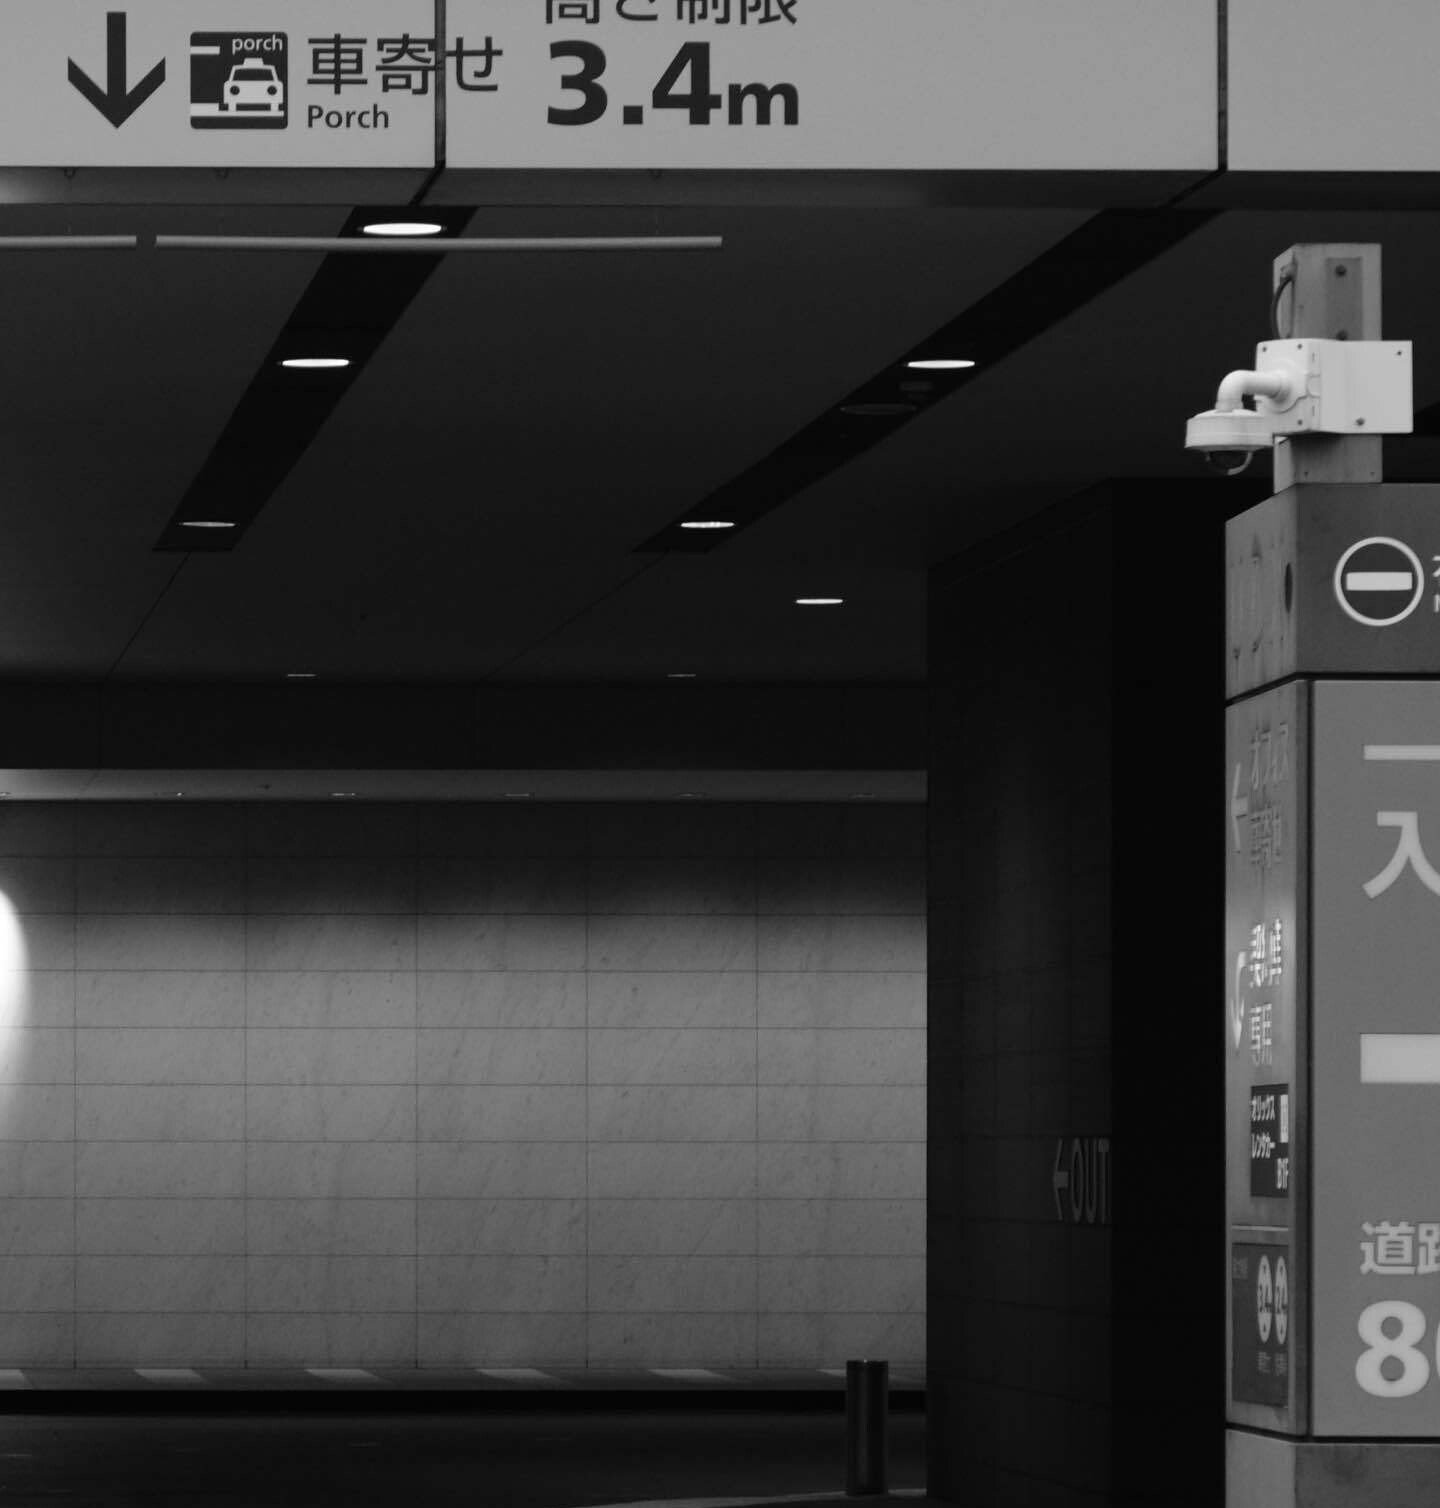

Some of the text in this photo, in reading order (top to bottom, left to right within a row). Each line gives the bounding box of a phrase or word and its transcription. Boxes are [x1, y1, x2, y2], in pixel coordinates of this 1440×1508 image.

[232, 35, 283, 56] porch
[307, 33, 503, 95] 車寄せ
[547, 40, 799, 126] 3.4m
[307, 104, 390, 129] Porch
[1071, 1137, 1110, 1224] OUT
